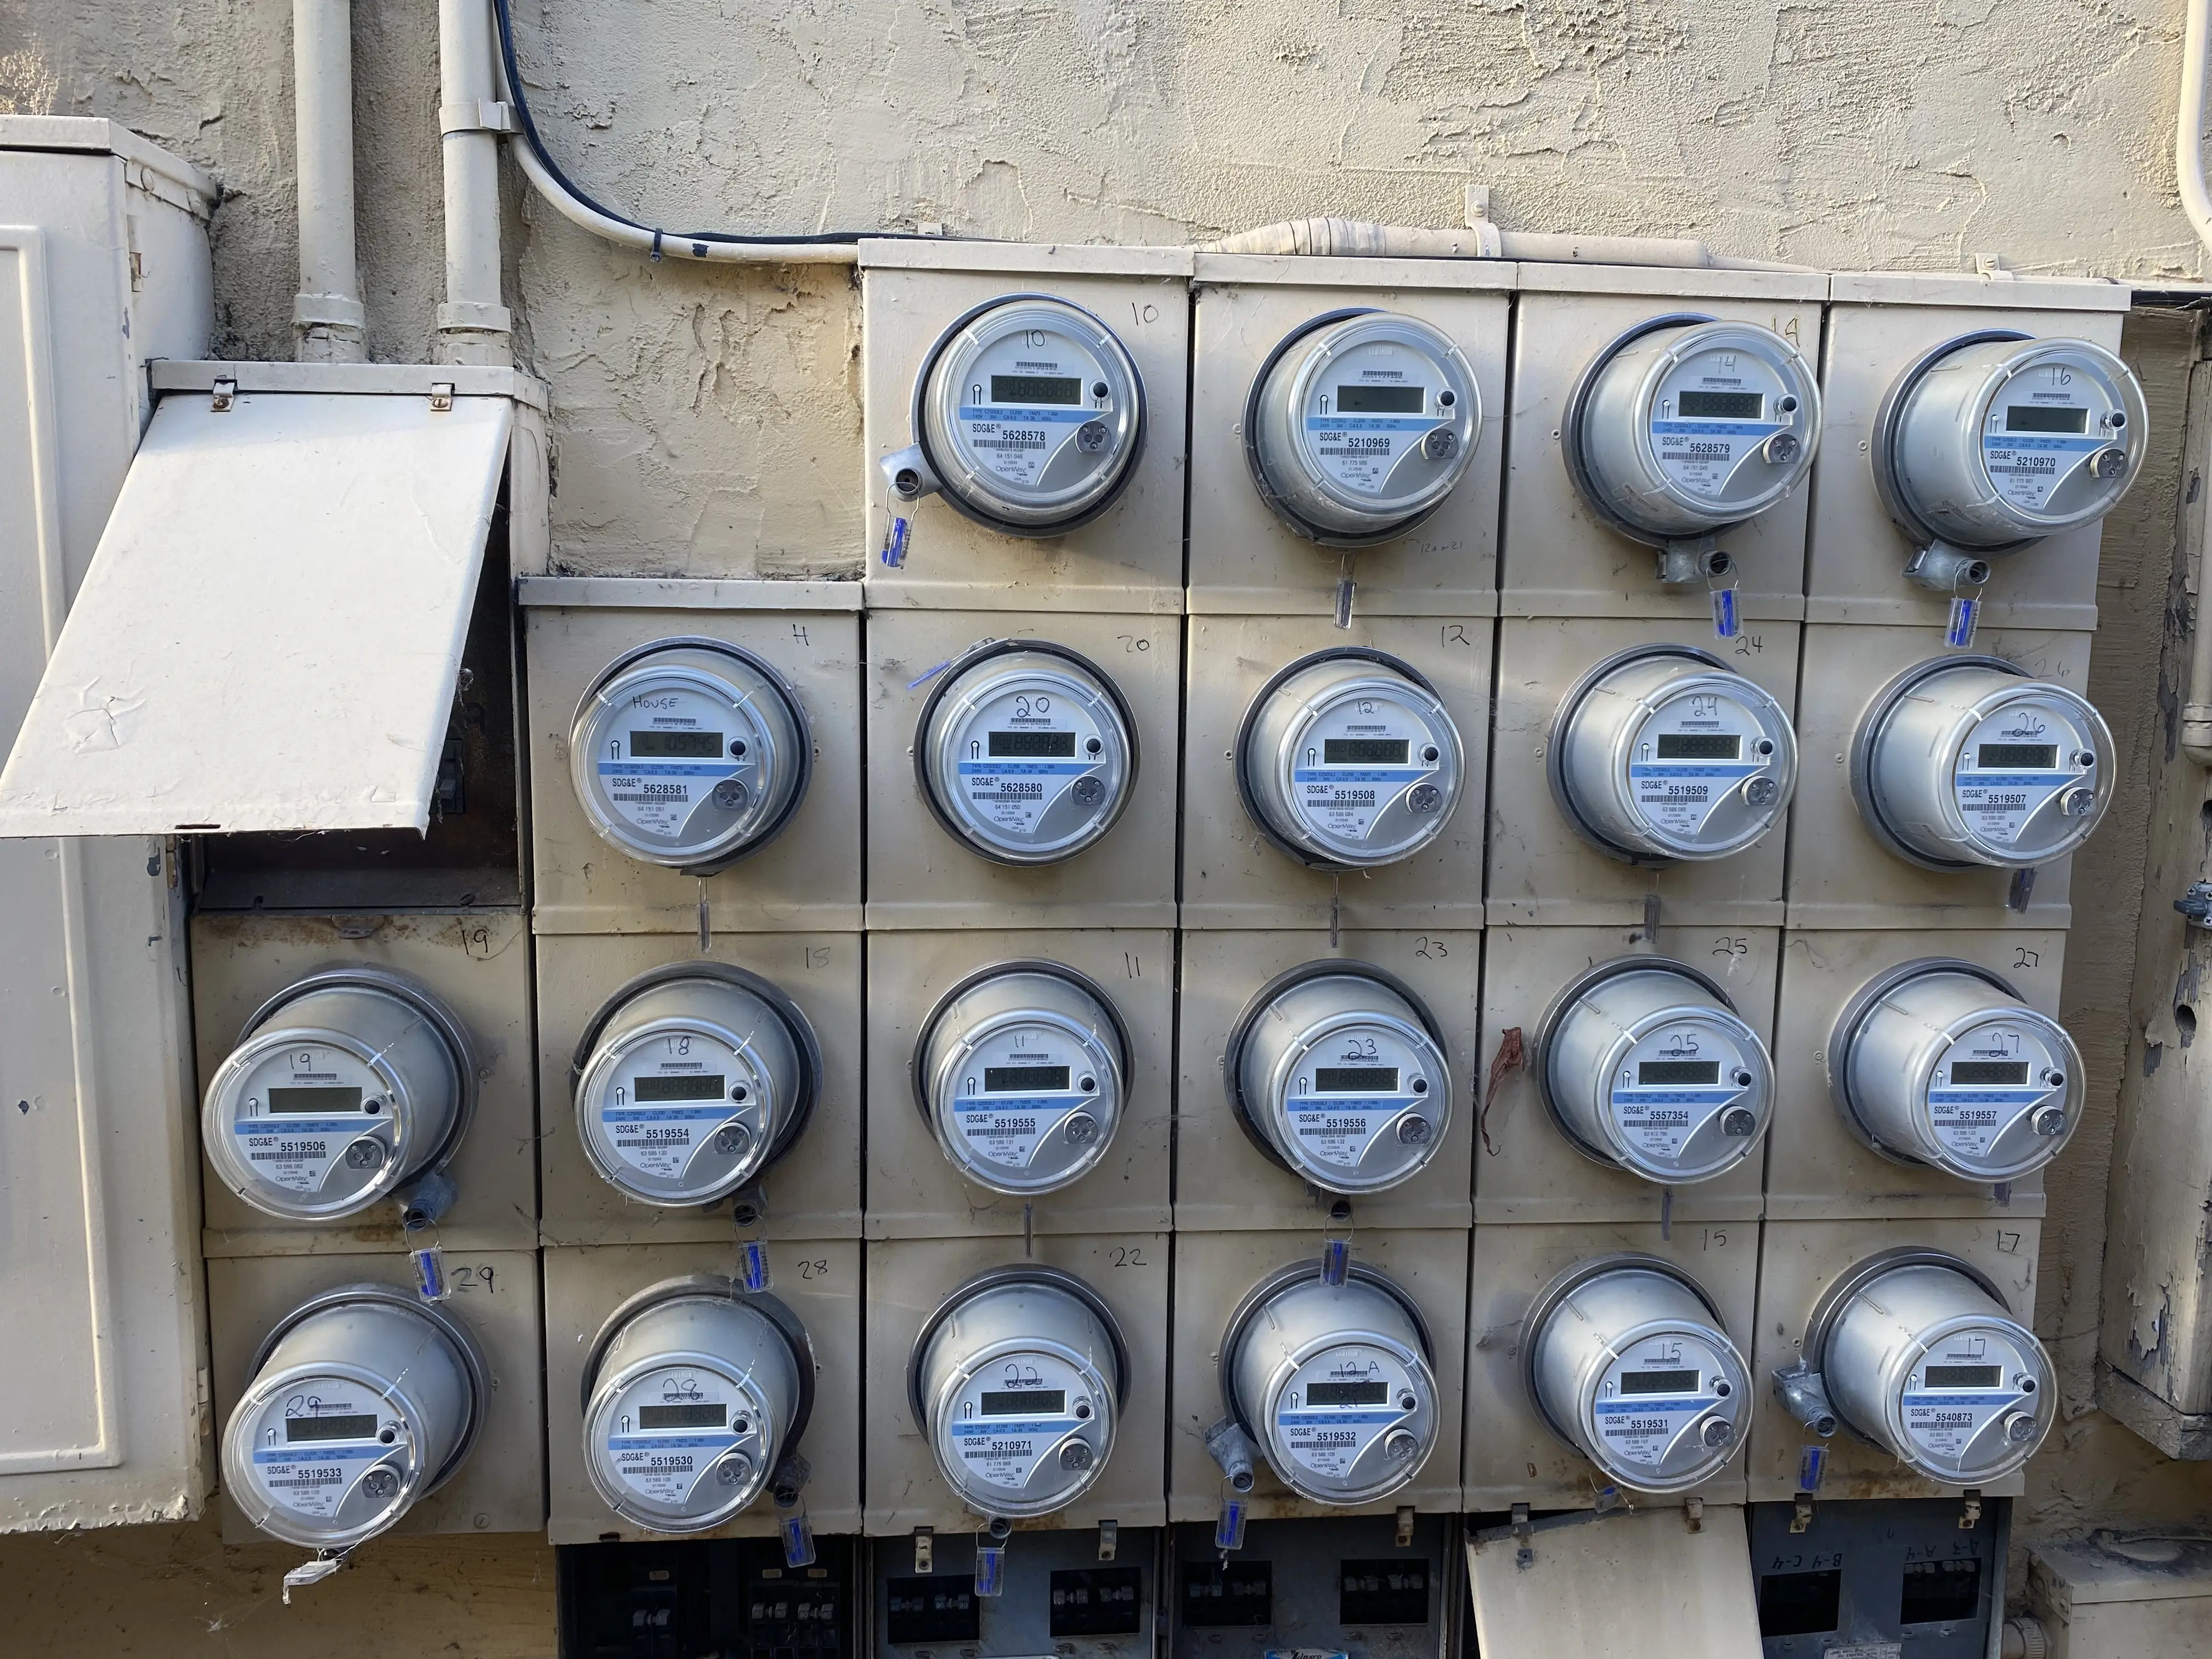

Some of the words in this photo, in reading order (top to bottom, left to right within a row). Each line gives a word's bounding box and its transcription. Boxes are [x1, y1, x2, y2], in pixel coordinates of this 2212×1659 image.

[1132, 302, 1159, 326] 10
[1026, 330, 1045, 348] 10
[2052, 367, 2071, 386] 16
[1002, 430, 1046, 441] 5628578
[1348, 438, 1390, 448] 5210969
[1689, 443, 1730, 453] 5628579
[2016, 456, 2056, 467] 5210970
[1441, 625, 1470, 647] 12
[1735, 635, 1763, 656] 24
[1016, 696, 1050, 718] 20
[1357, 702, 1374, 714] 12
[1694, 696, 1717, 716] 24
[2012, 713, 2045, 737] 26
[643, 784, 688, 794] 5628581
[1000, 783, 1042, 792] 5628580
[1334, 790, 1375, 799] 5519508
[1668, 785, 1708, 795] 5519509
[1988, 794, 2027, 804] 5519507
[461, 929, 488, 955] 19
[1415, 936, 1448, 960] 23
[1712, 936, 1747, 956] 25
[805, 946, 831, 969] 18
[1125, 952, 1141, 979] 11
[2013, 947, 2039, 968] 27
[668, 1036, 692, 1055] 18
[1348, 1039, 1376, 1060] 23
[1670, 1034, 1699, 1057] 25
[1989, 1033, 2020, 1057] 27
[289, 1054, 311, 1072] 19
[994, 1118, 1036, 1128] 5519555
[1326, 1118, 1366, 1128] 5519556
[1650, 1110, 1689, 1120] 5557354
[1959, 1110, 1997, 1119] 5519557
[646, 1128, 689, 1139] 5519554
[280, 1141, 326, 1152] 5519506
[1704, 1229, 1726, 1251] 15
[1997, 1229, 2020, 1252] 17
[1109, 1247, 1147, 1267] 22
[798, 1259, 828, 1279] 28
[452, 1266, 494, 1294] 29
[1662, 1343, 1681, 1360] 15
[1968, 1338, 1985, 1356] 17
[1005, 1364, 1039, 1387] 22
[1340, 1362, 1358, 1378] 12
[1369, 1361, 1380, 1373] A
[663, 1378, 699, 1401] 28
[286, 1395, 321, 1421] 29
[1936, 1413, 1973, 1421] 5540873
[1630, 1419, 1669, 1429] 5519531
[1317, 1431, 1356, 1441] 5519532
[992, 1440, 1032, 1451] 5210971
[651, 1455, 692, 1466] 5519530
[297, 1468, 342, 1479] 5519533
[1772, 1555, 1802, 1569] C-4
[1812, 1553, 1842, 1568] B-4
